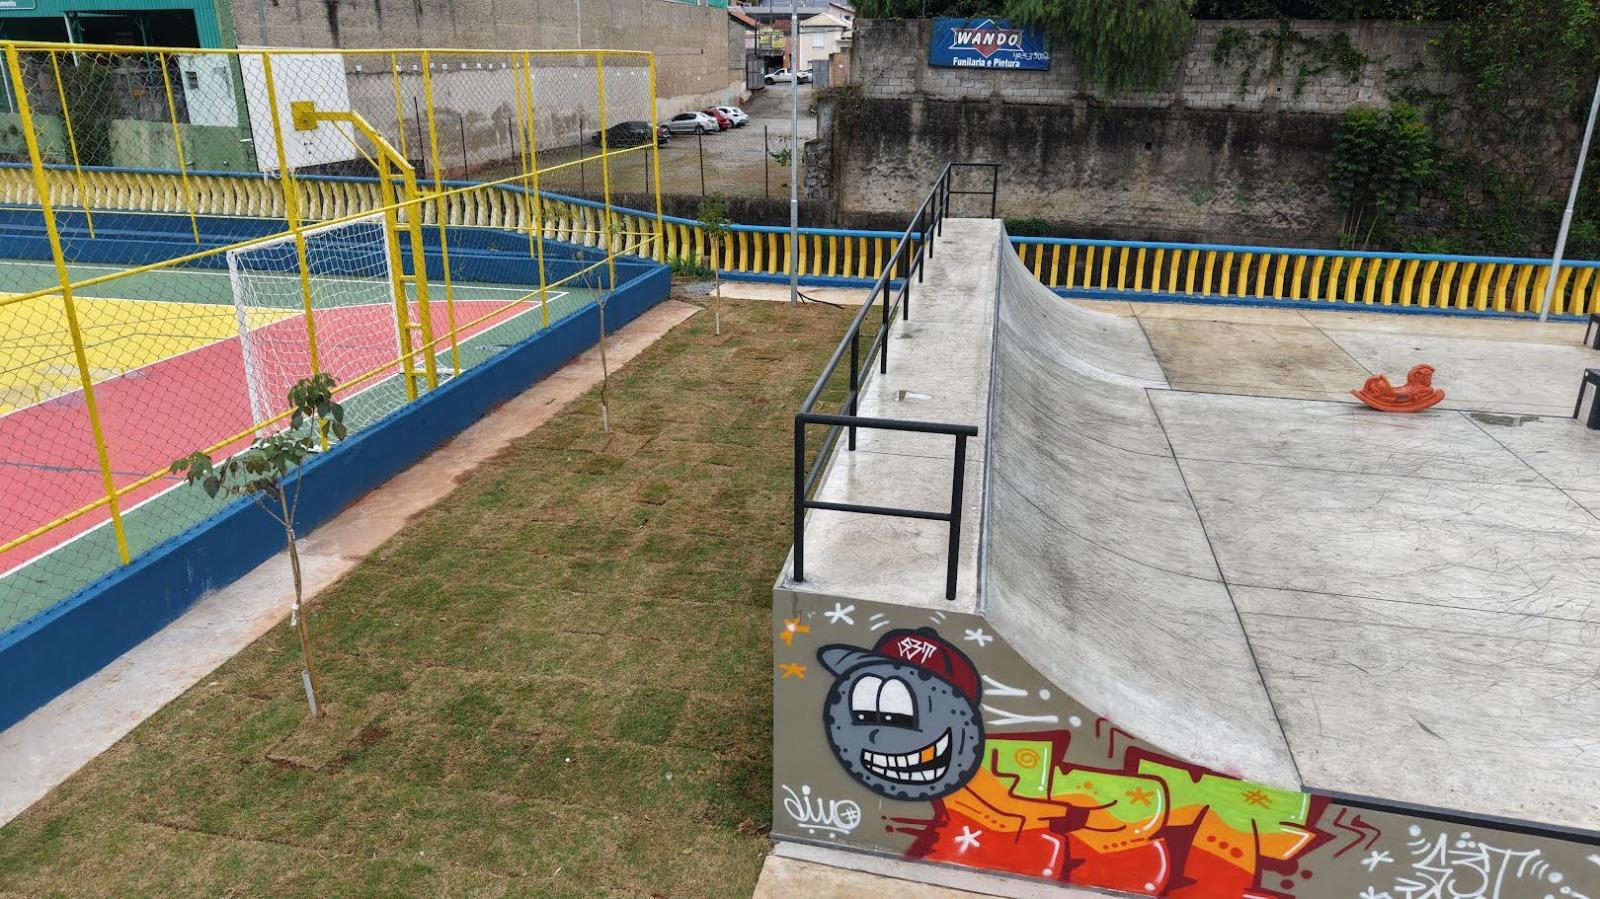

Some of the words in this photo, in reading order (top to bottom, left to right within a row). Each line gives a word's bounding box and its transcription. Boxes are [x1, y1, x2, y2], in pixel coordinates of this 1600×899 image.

[957, 32, 1019, 46] WANDO
[953, 57, 985, 67] Funilaria
[993, 58, 1020, 68] Pintura
